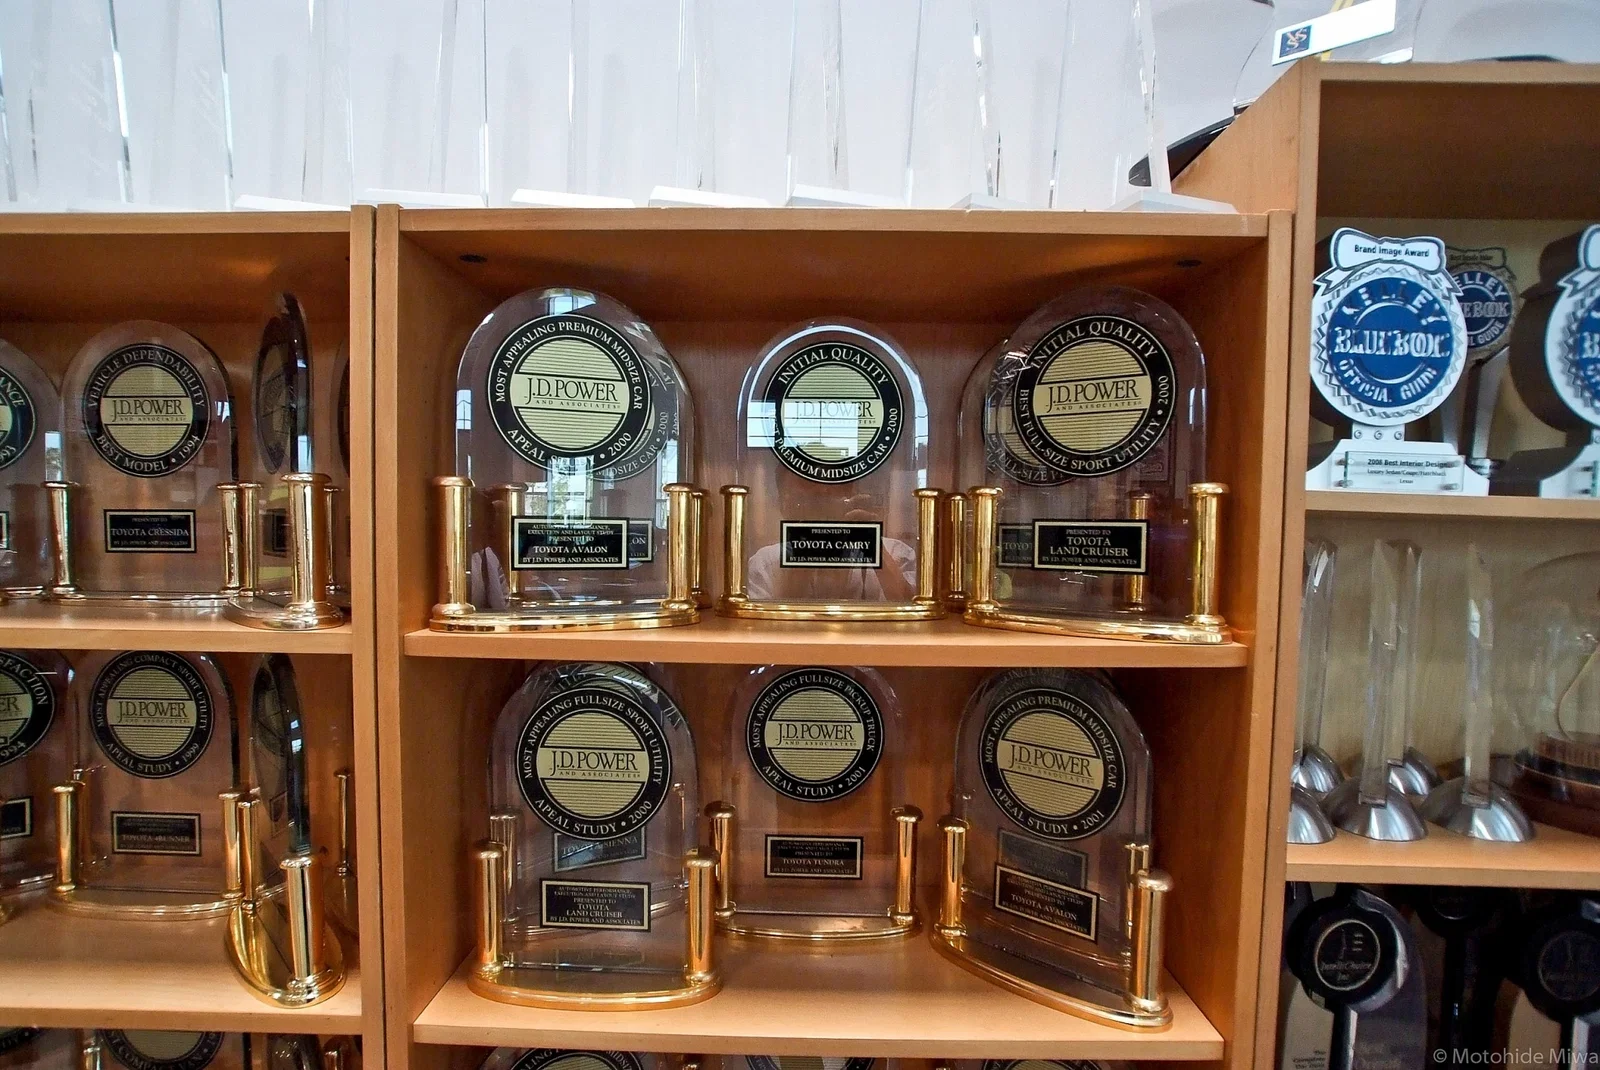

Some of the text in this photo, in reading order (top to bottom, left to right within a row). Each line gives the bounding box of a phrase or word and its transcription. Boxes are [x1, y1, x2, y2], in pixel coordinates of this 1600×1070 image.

[1354, 244, 1430, 257] Brand Image Award
[1452, 272, 1508, 297] ELLEY
[1031, 321, 1158, 368] INITIAL QUALITY
[1477, 320, 1505, 344] GUIDE
[88, 358, 120, 407] VEHICLE
[122, 349, 204, 407] DEPENDABILITY
[495, 368, 508, 402] MOST
[503, 323, 556, 367] APPEALING
[558, 321, 612, 346] PREMIUM
[610, 341, 641, 384] MIDSIZE
[633, 385, 643, 410] CAR
[778, 347, 889, 385] INITIAL QUALITY
[560, 401, 617, 409] ASSOCIATES
[1079, 401, 1138, 410] ASSOCIATES
[657, 411, 668, 435] 2000
[1020, 375, 1169, 470] BEST FULL-SIZE SPORT UTILITY 2000
[96, 434, 200, 472] BEST MODEL 1994
[507, 429, 546, 462] APEAL
[608, 432, 632, 456] 2000
[640, 445, 658, 463] CAR
[775, 407, 898, 478] PREMIUM MIDSIZE CAR 2000
[1384, 459, 1399, 467] Best
[111, 528, 189, 536] TOYOTA CRESSIDA
[792, 540, 870, 549] TOYOTA CAMRY
[1066, 537, 1111, 546] TOYOTA
[533, 545, 608, 553] TOYOTA AVALON
[1050, 547, 1128, 557] LAND CRUISER
[96, 654, 208, 731] MOST APPEALING COMPACT SPORT UTILITY
[753, 674, 876, 752] MOST APPEALING FULLSIZE PICKUP TRUCK
[523, 748, 533, 779] MOST
[528, 699, 573, 746] APPEALING
[574, 695, 626, 711] FULLSIZE
[625, 707, 654, 737] SPORT
[650, 738, 663, 785] UTILITY
[985, 695, 1117, 789] MOST APPEALING PREMIUM MIDSIZE CAR
[106, 742, 199, 773] APEAL STUDY 1999
[763, 765, 866, 796] APEAL STUDY 2001
[535, 799, 653, 835] APEAL STUDY 2000
[994, 787, 1105, 834] APEAL STUDY 2001
[604, 836, 638, 848] SIENNA
[1011, 894, 1041, 909] TOYOTA
[1043, 904, 1077, 920] AVALON
